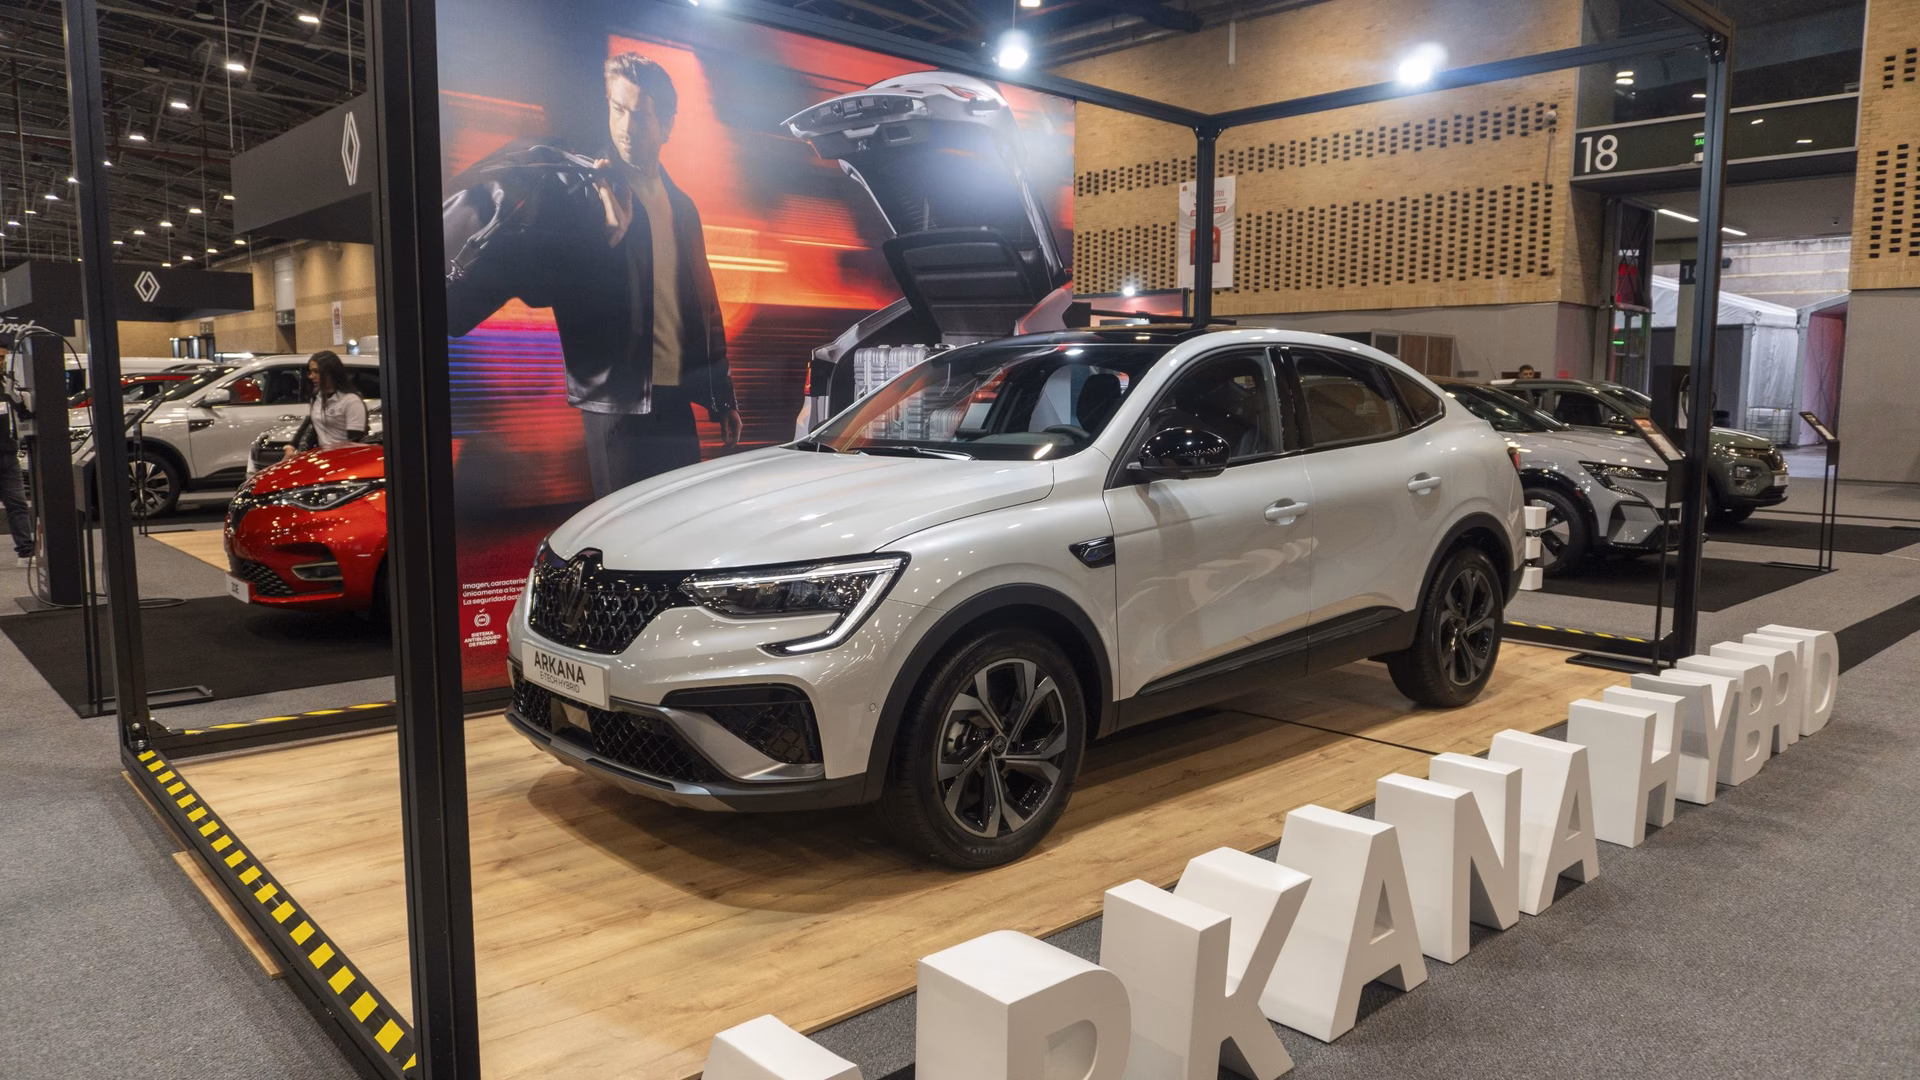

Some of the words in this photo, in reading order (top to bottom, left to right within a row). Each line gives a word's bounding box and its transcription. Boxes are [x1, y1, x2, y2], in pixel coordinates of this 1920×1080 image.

[1580, 134, 1619, 173] 18
[0, 316, 35, 333] ord
[462, 582, 490, 590] Imagen,
[490, 577, 528, 587] característ
[462, 588, 502, 598] únicamente
[463, 598, 472, 606] La
[472, 595, 506, 605] seguridad
[464, 634, 501, 643] ANTIBLOQUEO
[534, 651, 586, 686] ARKANA
[540, 671, 558, 686] E-TECH
[558, 678, 580, 693] HYBRID
[702, 729, 1600, 1080] KANA
[1567, 624, 1839, 848] HYBRID
